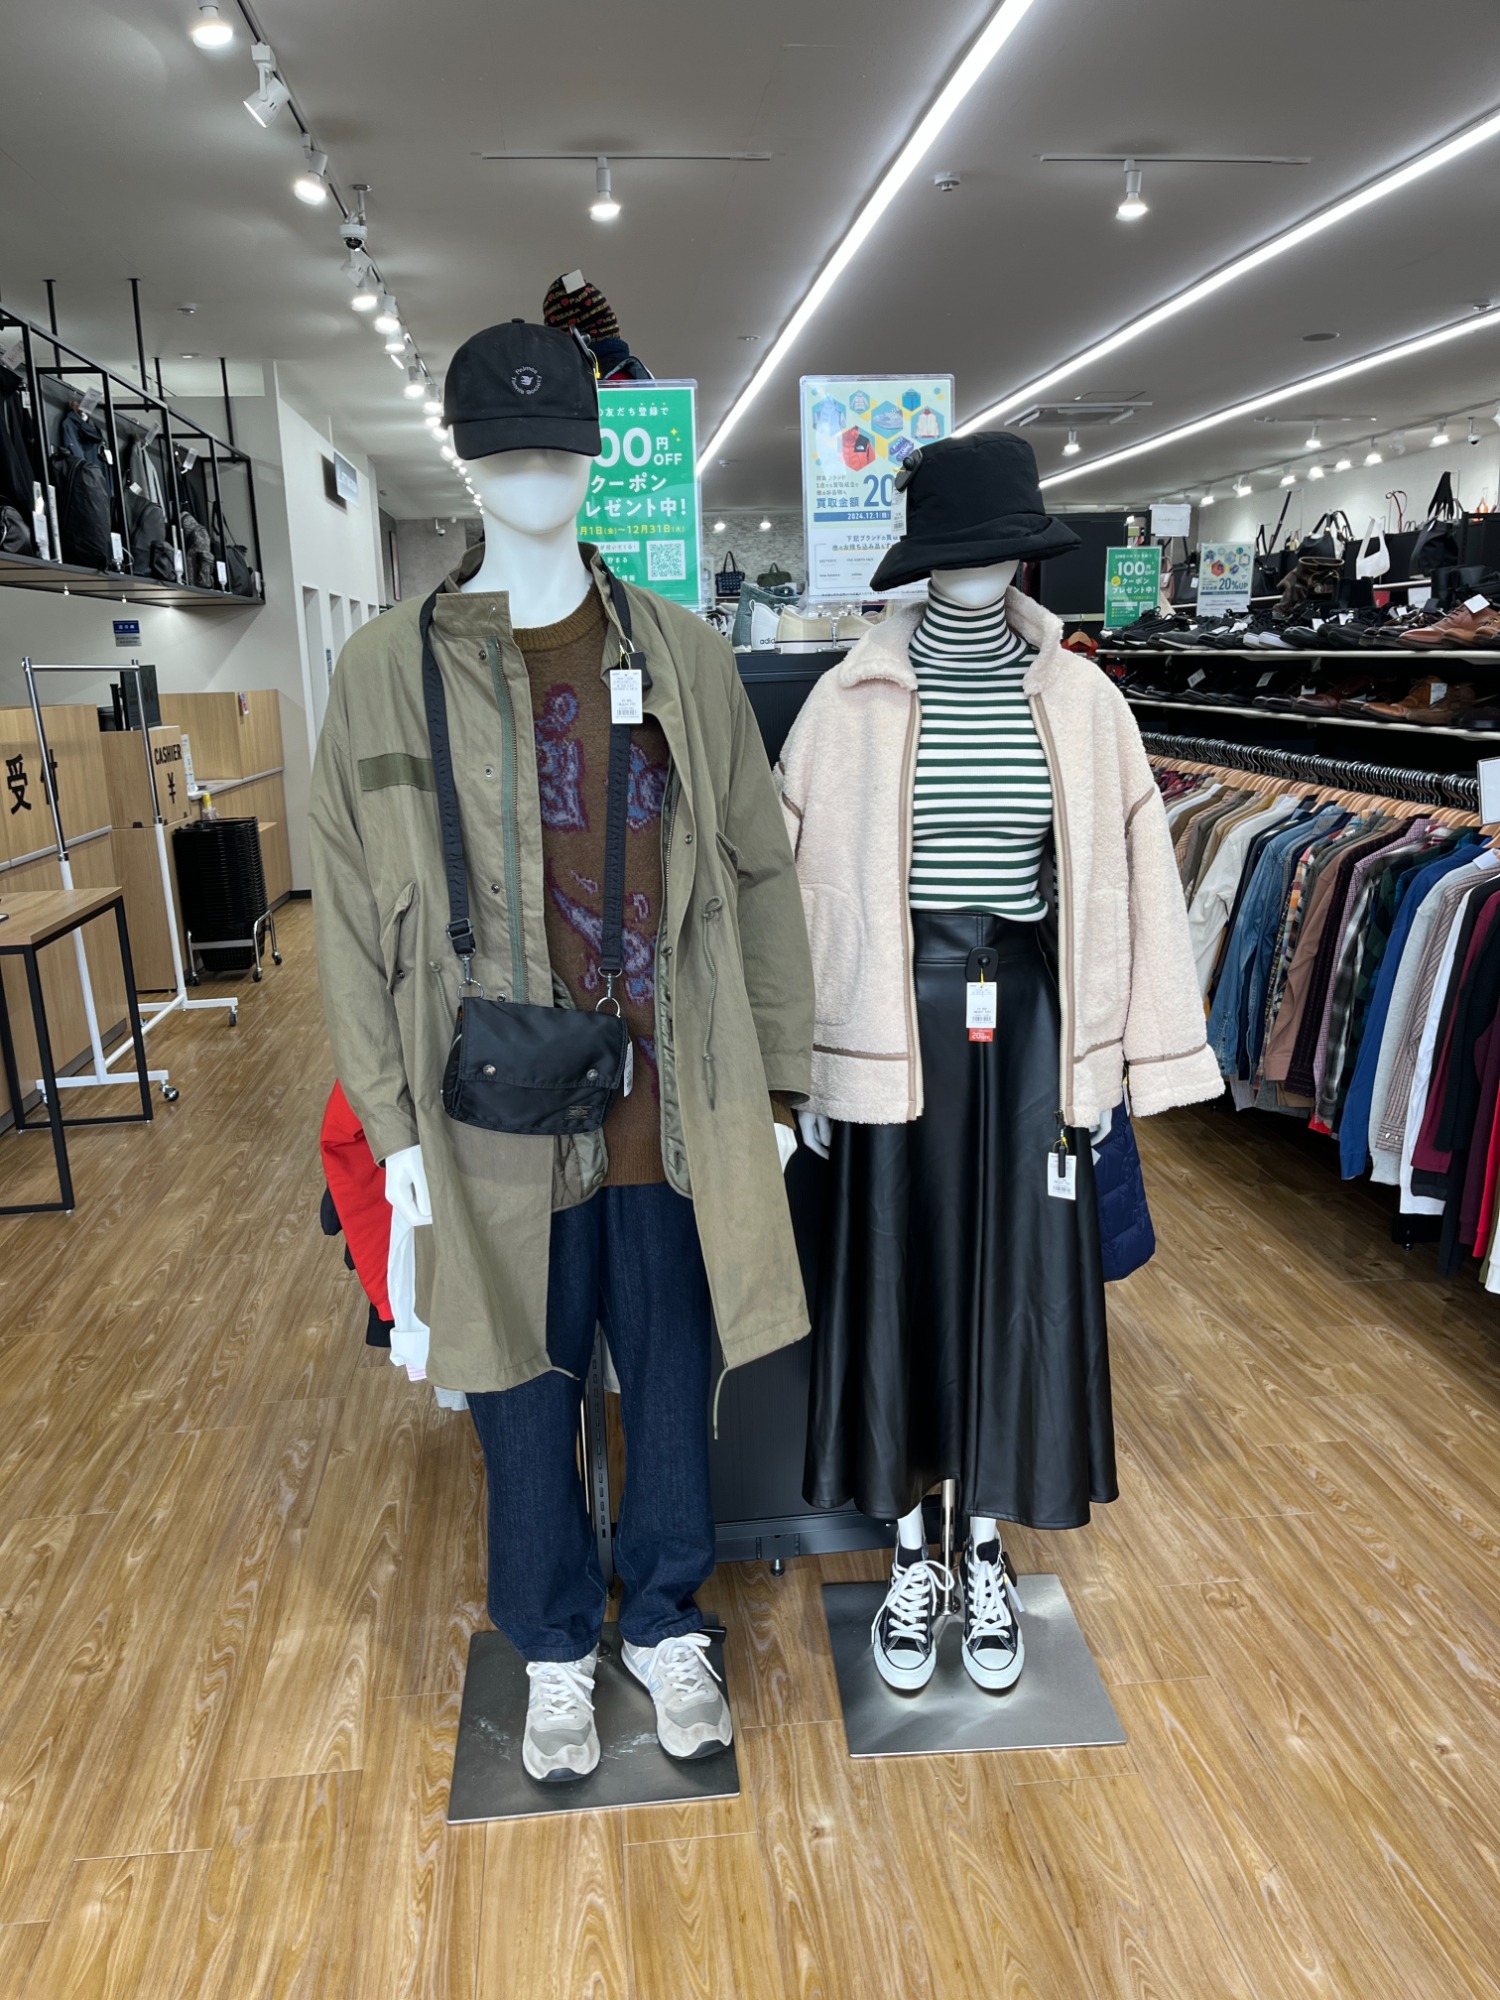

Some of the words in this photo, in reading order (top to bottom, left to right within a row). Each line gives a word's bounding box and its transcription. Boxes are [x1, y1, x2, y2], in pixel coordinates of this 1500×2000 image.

[653, 452, 683, 466] OFF
[591, 472, 667, 494] クーポン
[816, 497, 860, 509] 買取金額
[863, 474, 895, 507] 20
[1118, 561, 1146, 576] 100
[155, 744, 182, 765] CASHIER
